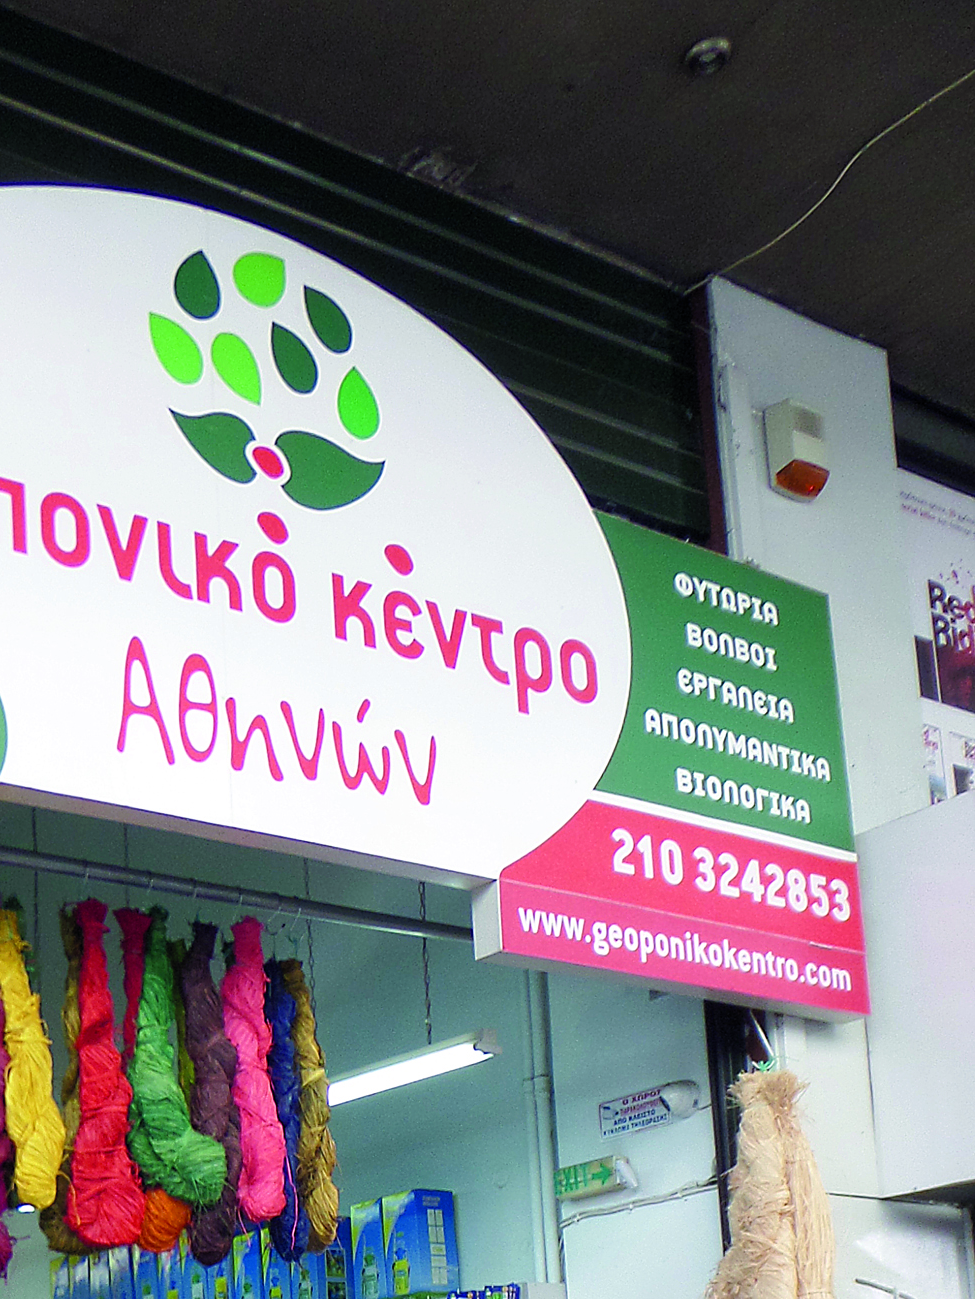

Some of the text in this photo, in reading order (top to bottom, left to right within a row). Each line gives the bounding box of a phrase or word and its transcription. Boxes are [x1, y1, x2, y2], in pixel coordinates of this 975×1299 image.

[331, 543, 600, 715] κέντρο
[674, 572, 779, 627] ΦΥΤΩΡΙΑ
[686, 622, 778, 672] ΒΟΛΒΟΙ
[116, 636, 437, 805] Αθηνών
[677, 667, 795, 725] ΕΡΓΑΛΕΙΑ
[644, 708, 832, 783] ΑΠΟΛΥΜΑΝΤΙΚΑ
[675, 767, 812, 824] ΒΙΟΛΟΓΙΚΑ
[610, 827, 852, 923] 210 3242853
[517, 906, 852, 992] www.geoponikokentro.com
